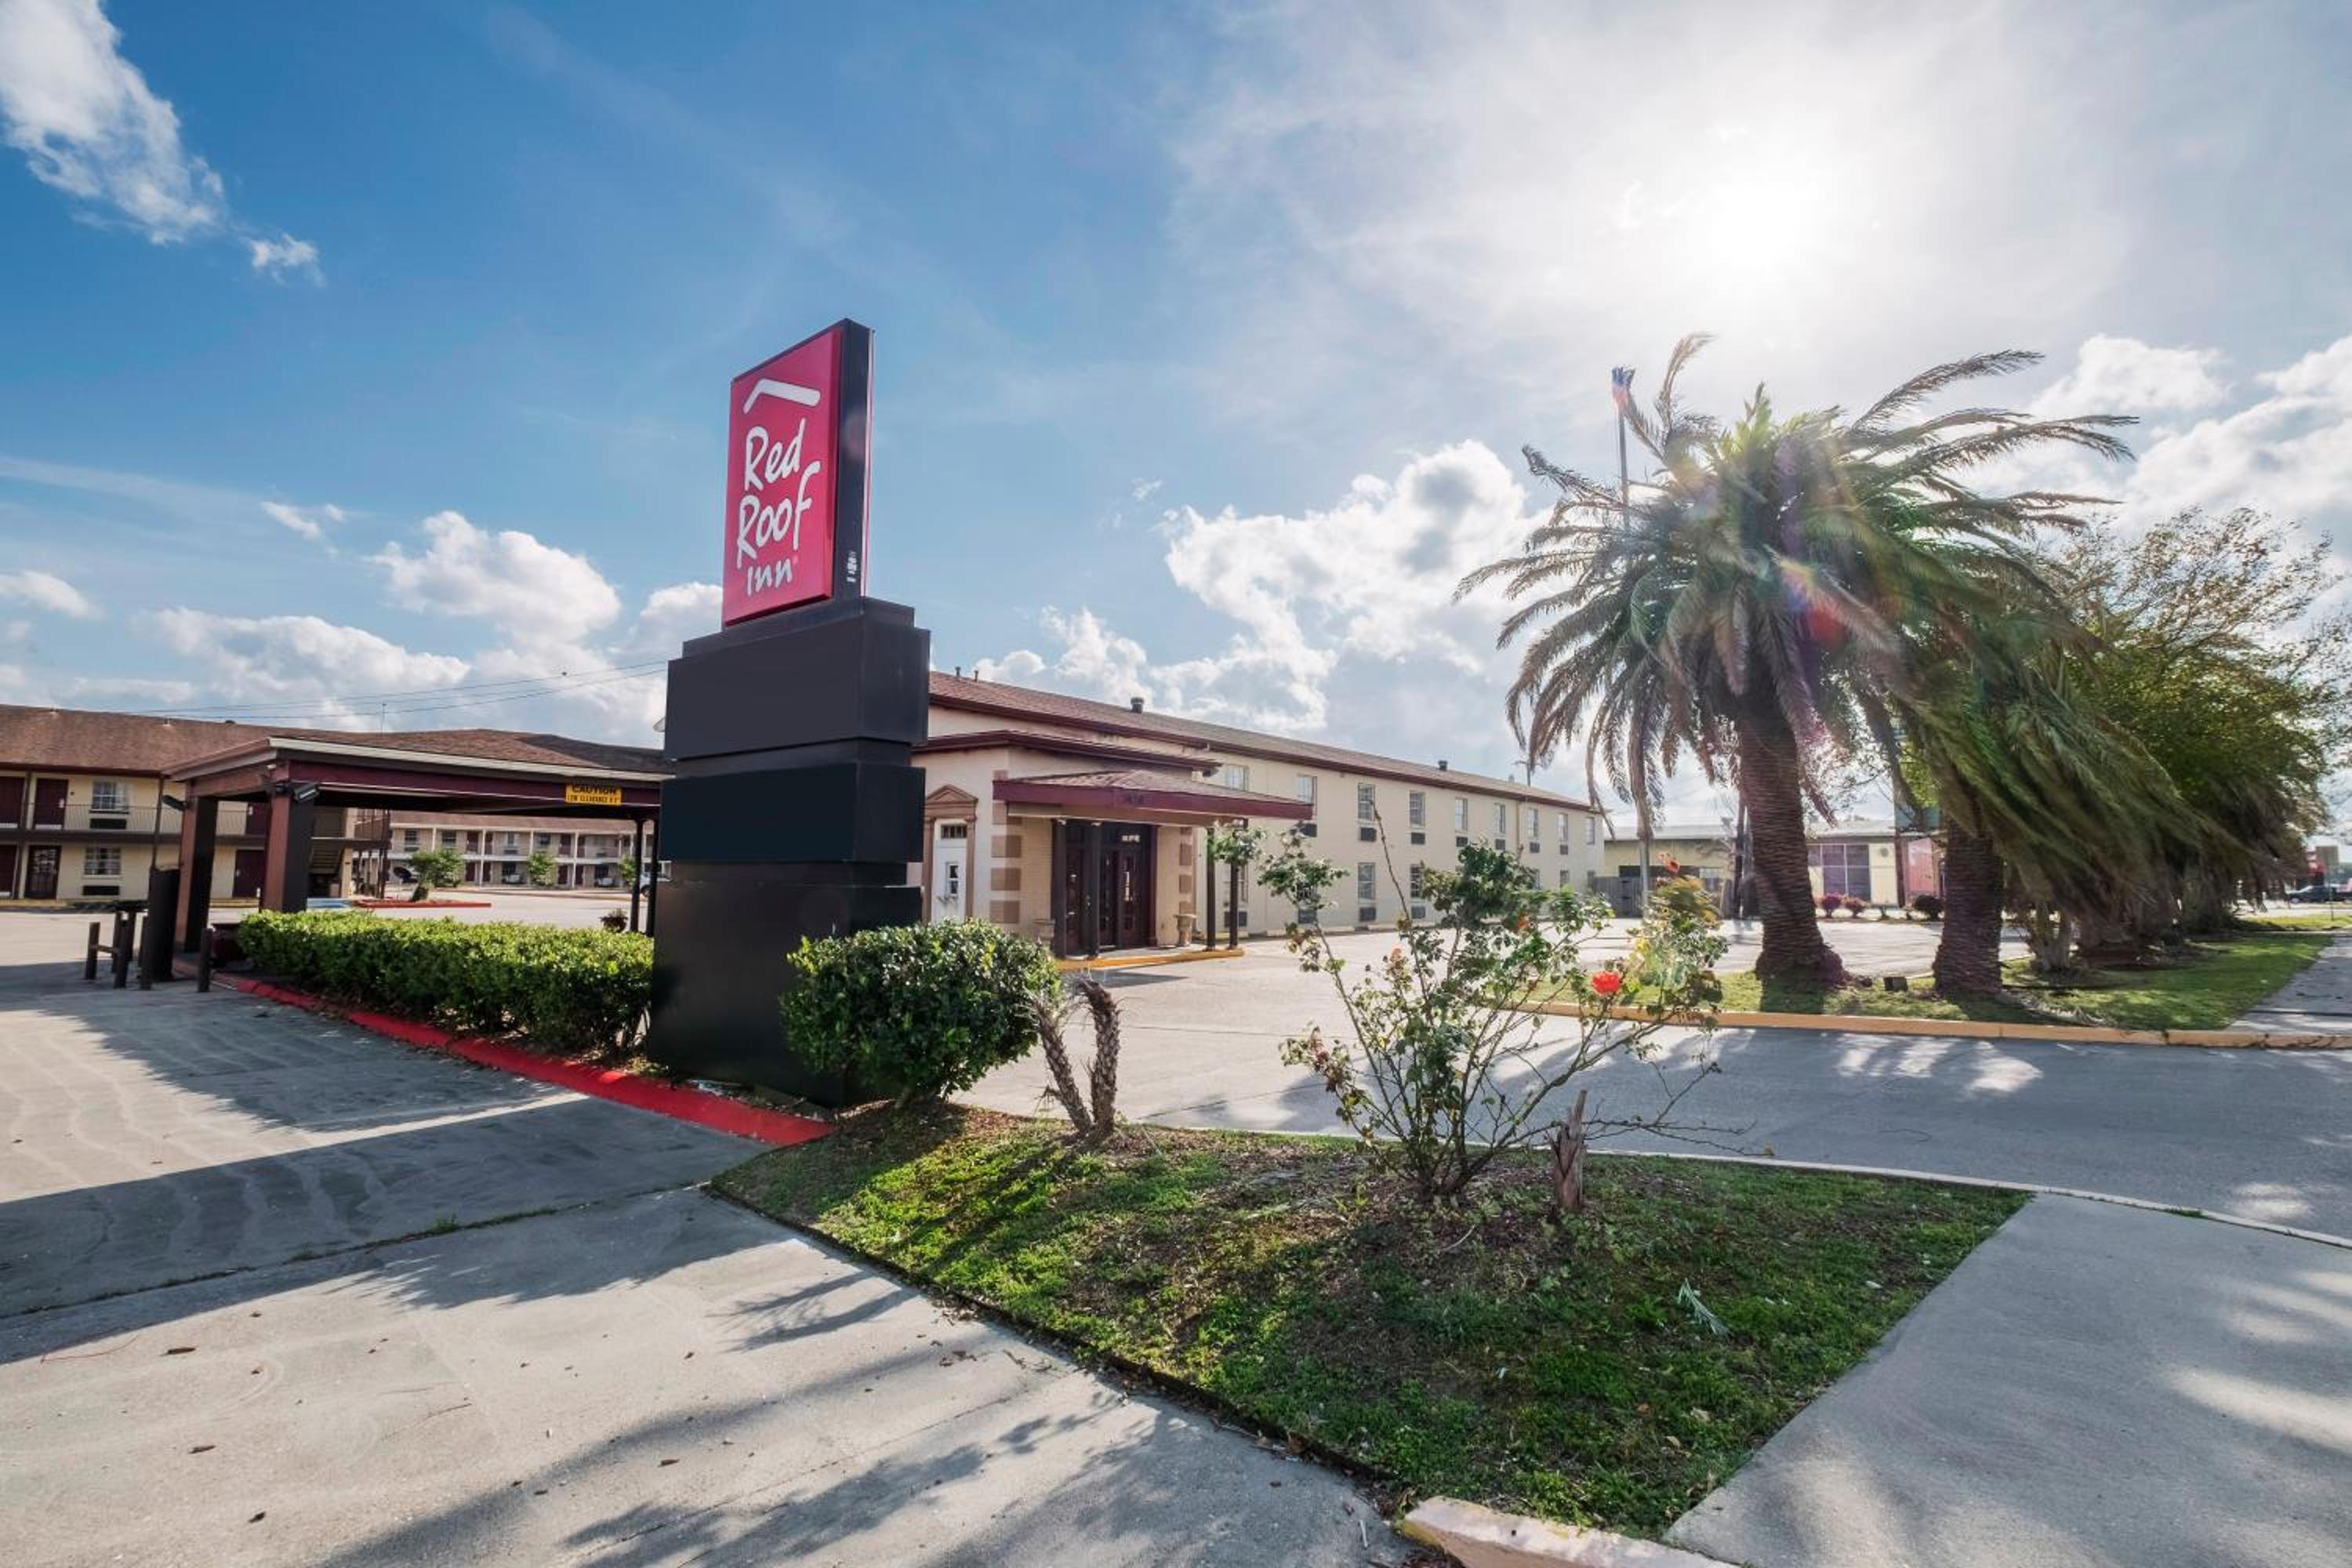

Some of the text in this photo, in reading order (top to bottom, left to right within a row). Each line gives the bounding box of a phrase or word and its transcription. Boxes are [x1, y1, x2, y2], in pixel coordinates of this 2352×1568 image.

[745, 417, 806, 492] Red
[736, 460, 821, 569] Roof
[572, 784, 617, 795] CAUTION
